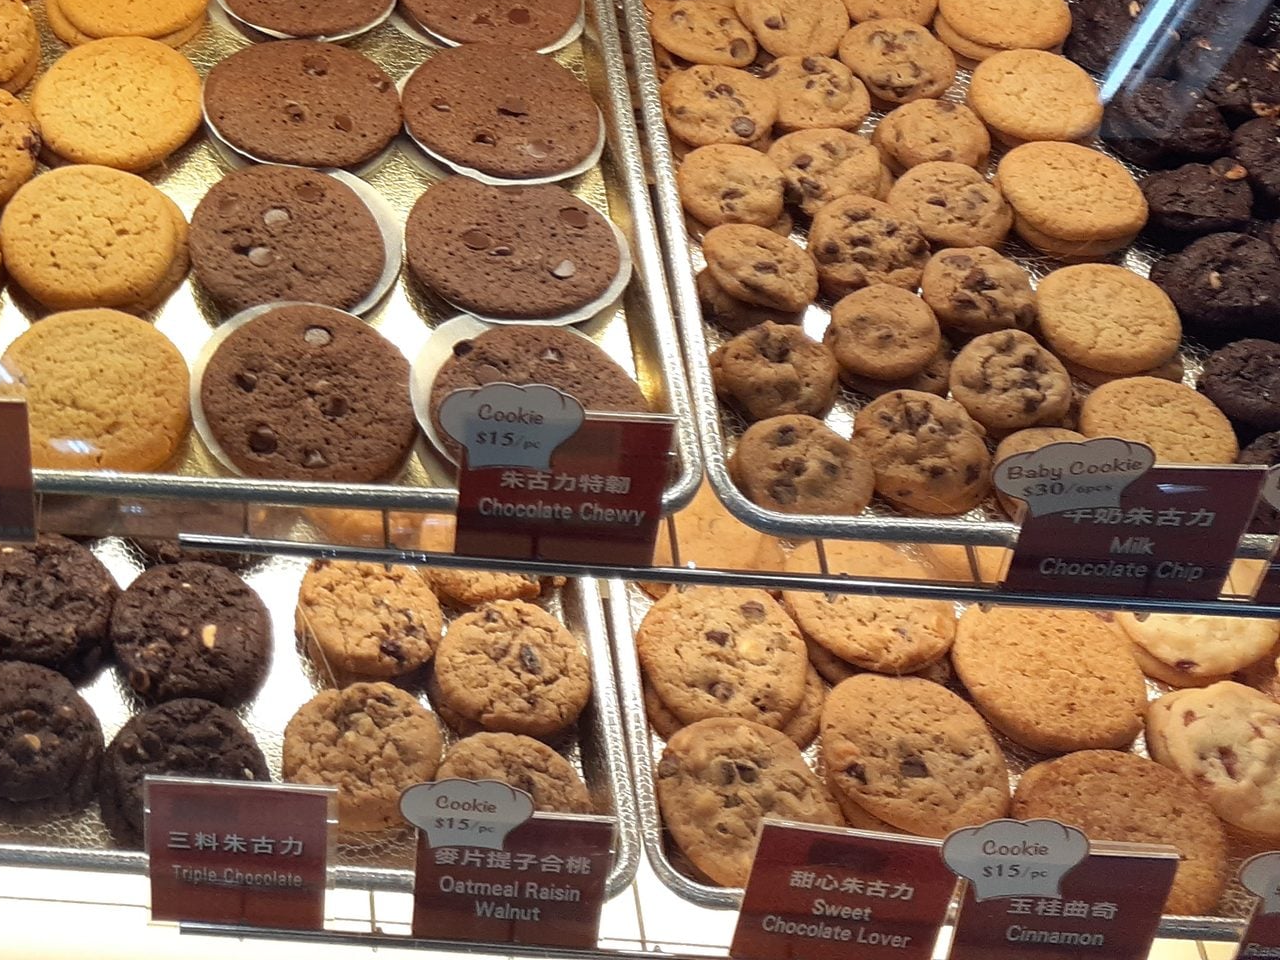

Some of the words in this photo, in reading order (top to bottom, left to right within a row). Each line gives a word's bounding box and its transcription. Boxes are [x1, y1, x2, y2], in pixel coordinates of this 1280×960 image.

[478, 404, 544, 425] Cookie
[1007, 461, 1062, 481] Baby
[1069, 457, 1143, 476] Cookie
[478, 497, 573, 520] Chocolate
[579, 502, 646, 526] Chewy
[1063, 506, 1216, 528] 牛奶朱古力
[1109, 536, 1156, 555] Milk
[1039, 557, 1147, 578] Chocolate
[1155, 561, 1204, 582] Chip
[435, 795, 497, 814] Cookie
[167, 831, 304, 856] 三料朱古力
[982, 839, 1049, 857] Cookie
[172, 864, 217, 885] Triple
[223, 867, 303, 887] Chocolate
[982, 864, 1048, 881] $15/pc
[439, 875, 519, 898] Oatmeal
[524, 881, 581, 902] Raisin
[789, 870, 915, 900] 甜心朱古力
[475, 900, 541, 922] Walnut
[811, 898, 872, 922] Sweet
[1006, 897, 1119, 920] 玉桂曲奇
[761, 915, 852, 941] Chocolate
[856, 926, 912, 949] Lover
[1005, 925, 1105, 947] Cinnamon
